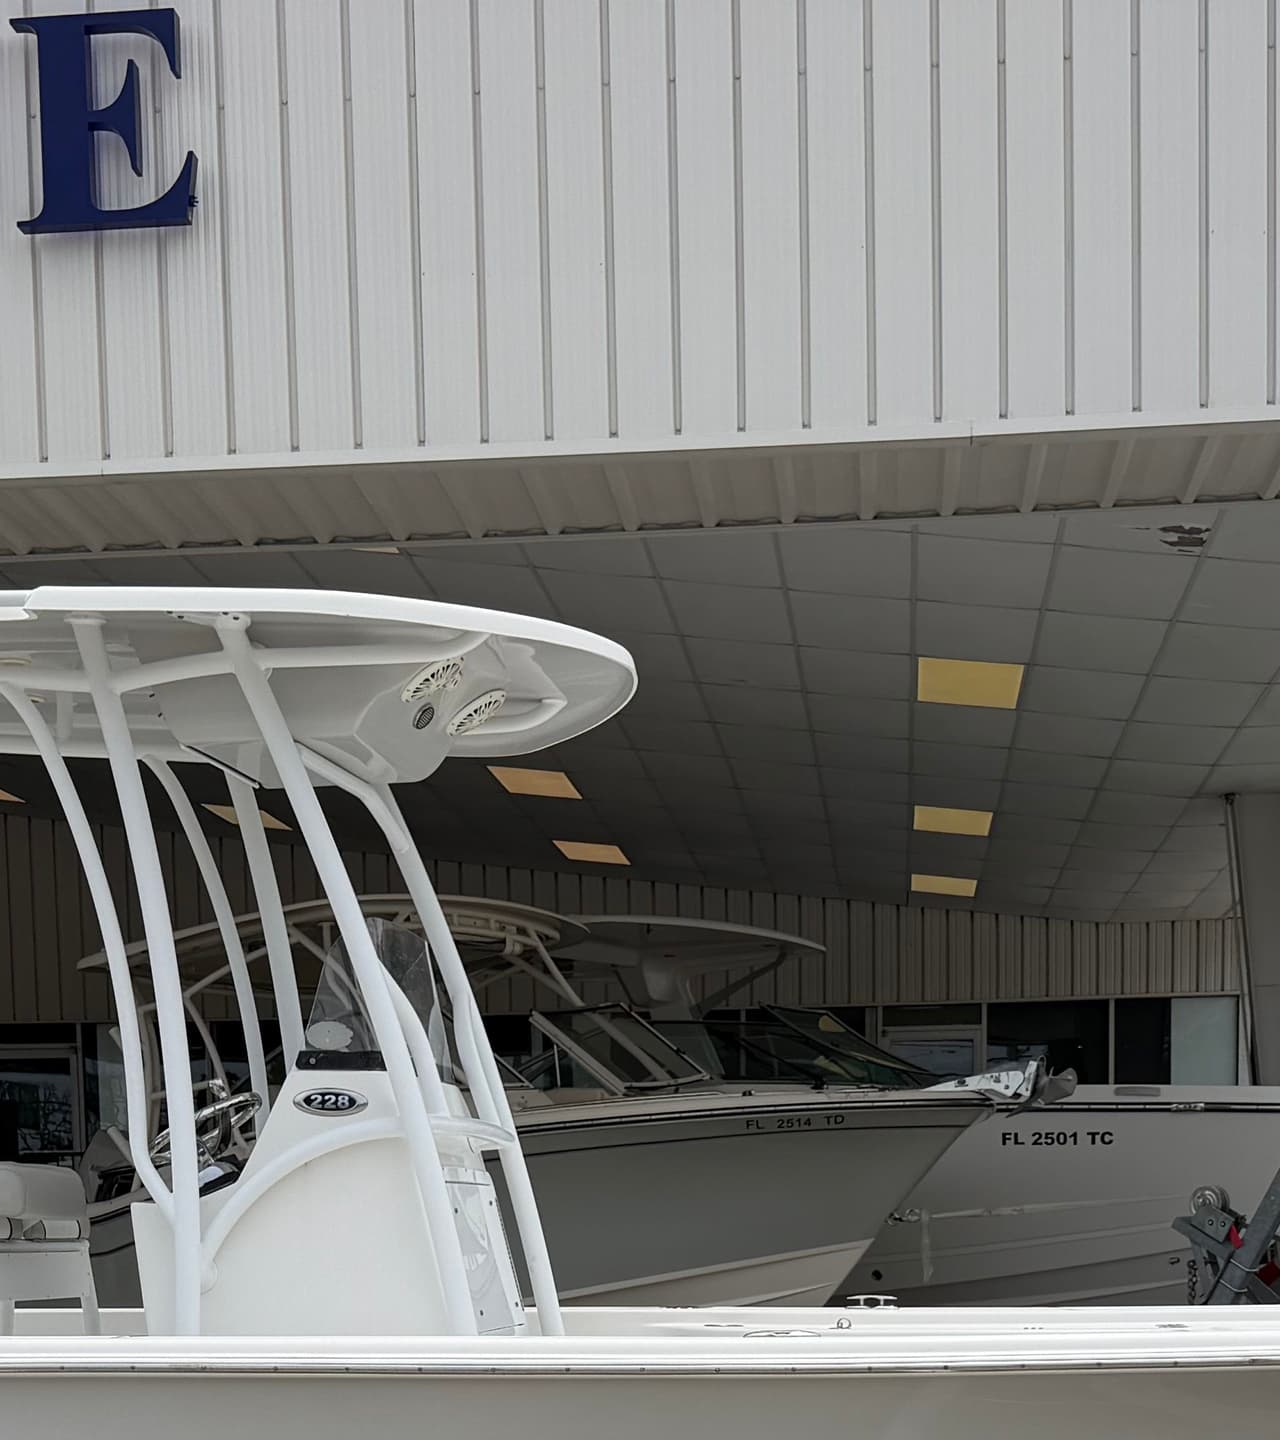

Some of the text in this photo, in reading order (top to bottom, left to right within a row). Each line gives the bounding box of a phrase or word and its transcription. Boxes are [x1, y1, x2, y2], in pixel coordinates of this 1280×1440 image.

[310, 1094, 350, 1109] 228
[745, 1114, 845, 1130] FL 2514 TD
[1001, 1131, 1114, 1146] FL 2501 TC
